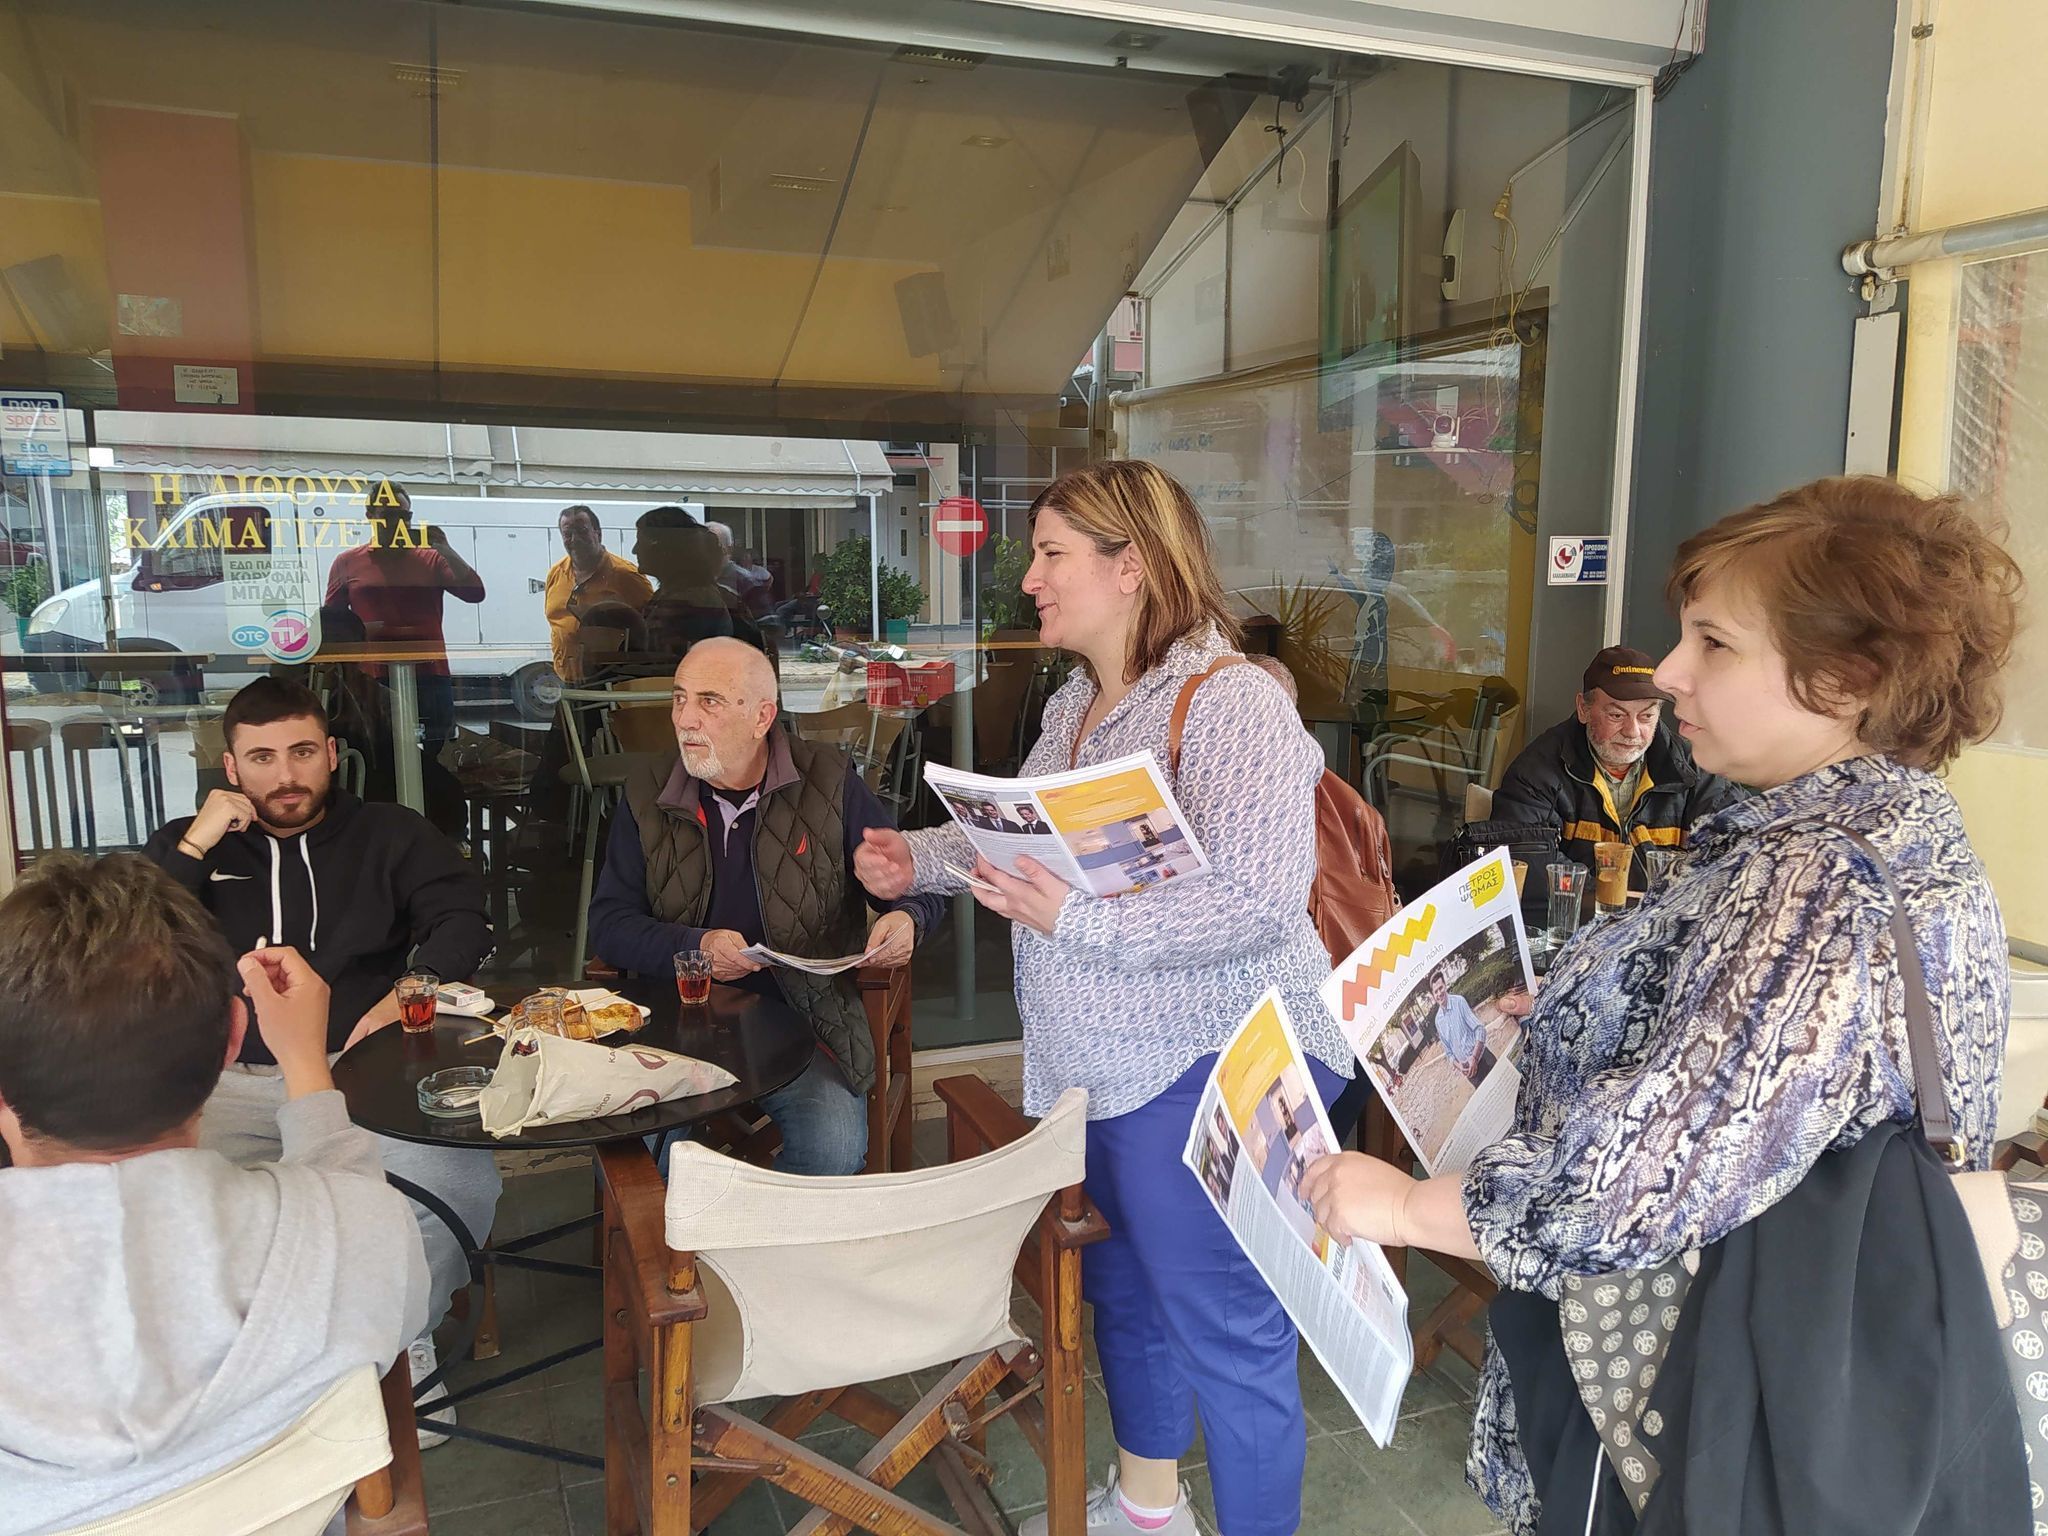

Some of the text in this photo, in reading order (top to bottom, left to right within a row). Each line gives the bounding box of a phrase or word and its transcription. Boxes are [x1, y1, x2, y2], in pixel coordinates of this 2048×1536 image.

[8, 400, 51, 411] nova
[151, 474, 183, 505] Η
[124, 518, 432, 549] ΚΛΙΜΑΤΙΖΕΤΑΙ
[230, 560, 308, 570] ΕΔΩ ΠΑΙΖΕΤΑΙ
[230, 571, 311, 584] ΚΟΡΥΦΑΙΑ
[231, 585, 302, 600] ΜΠΑΛΑ
[271, 627, 306, 645] TV
[1458, 867, 1498, 895] ΠΕΤΡΟΣ
[1460, 877, 1500, 903] ΨΩΜΑΣ
